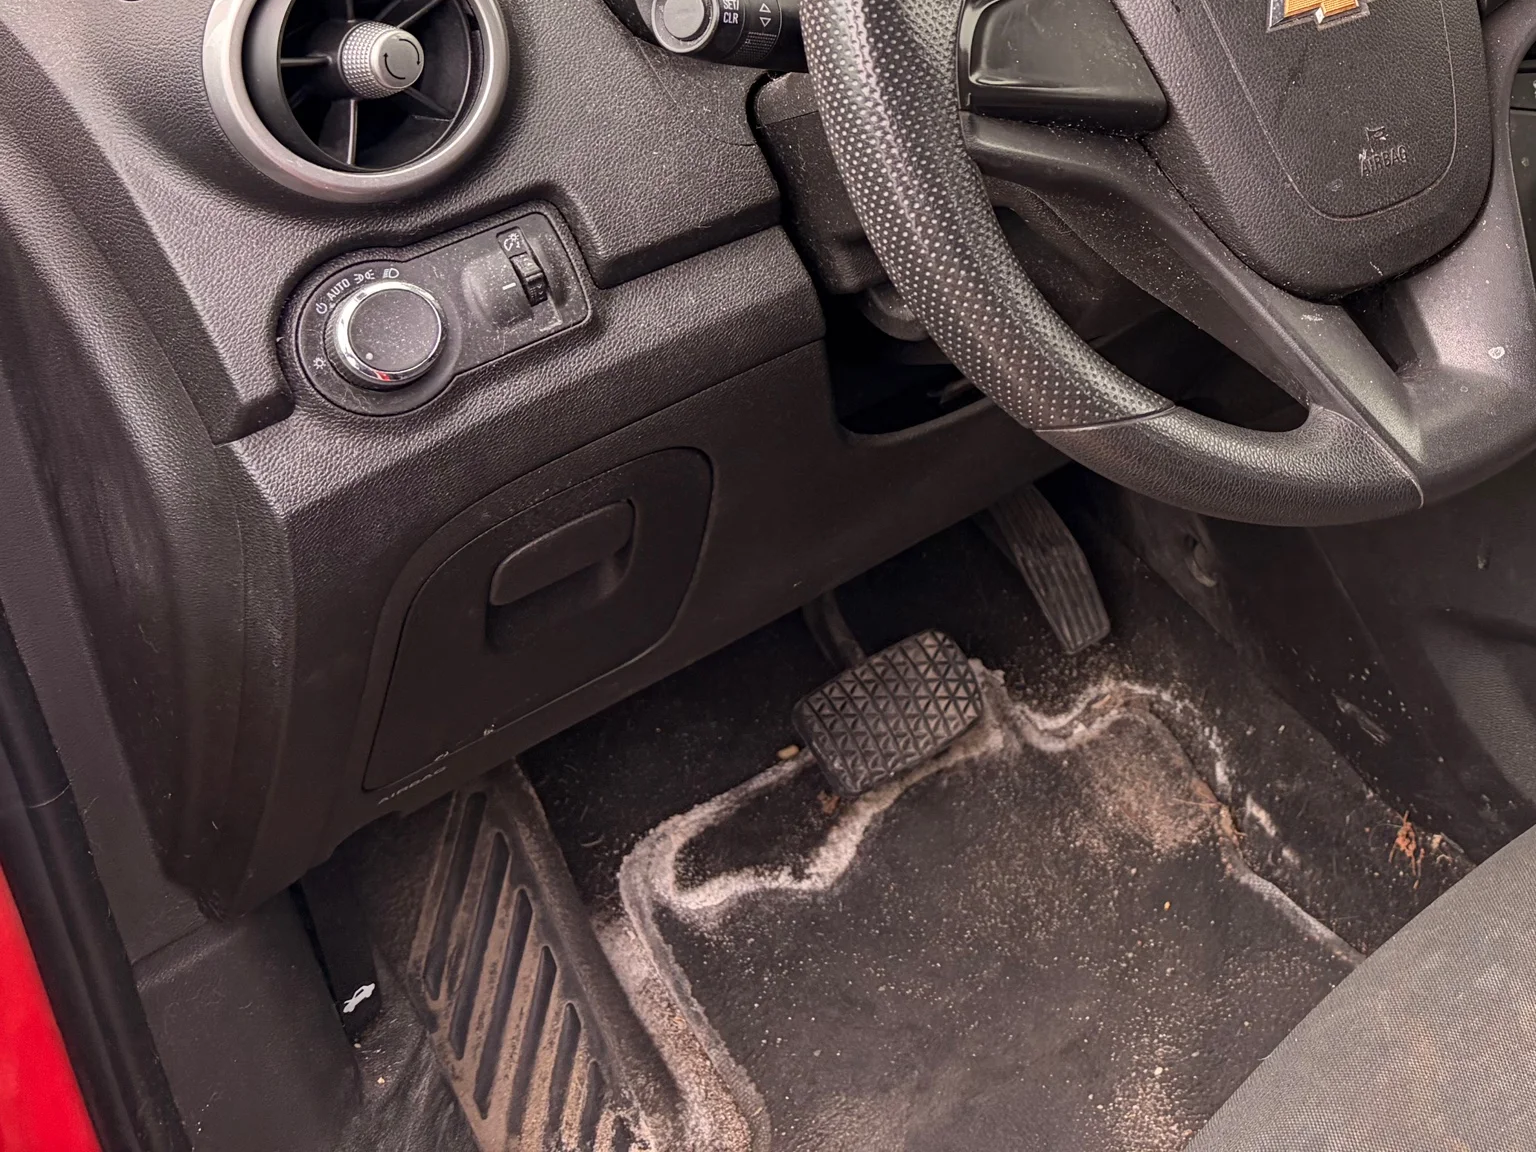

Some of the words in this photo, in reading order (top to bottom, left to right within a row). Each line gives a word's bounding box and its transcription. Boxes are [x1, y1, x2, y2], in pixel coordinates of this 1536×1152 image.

[722, 12, 739, 25] CLR
[1360, 145, 1406, 177] AIRBAG
[326, 278, 351, 301] AUTO
